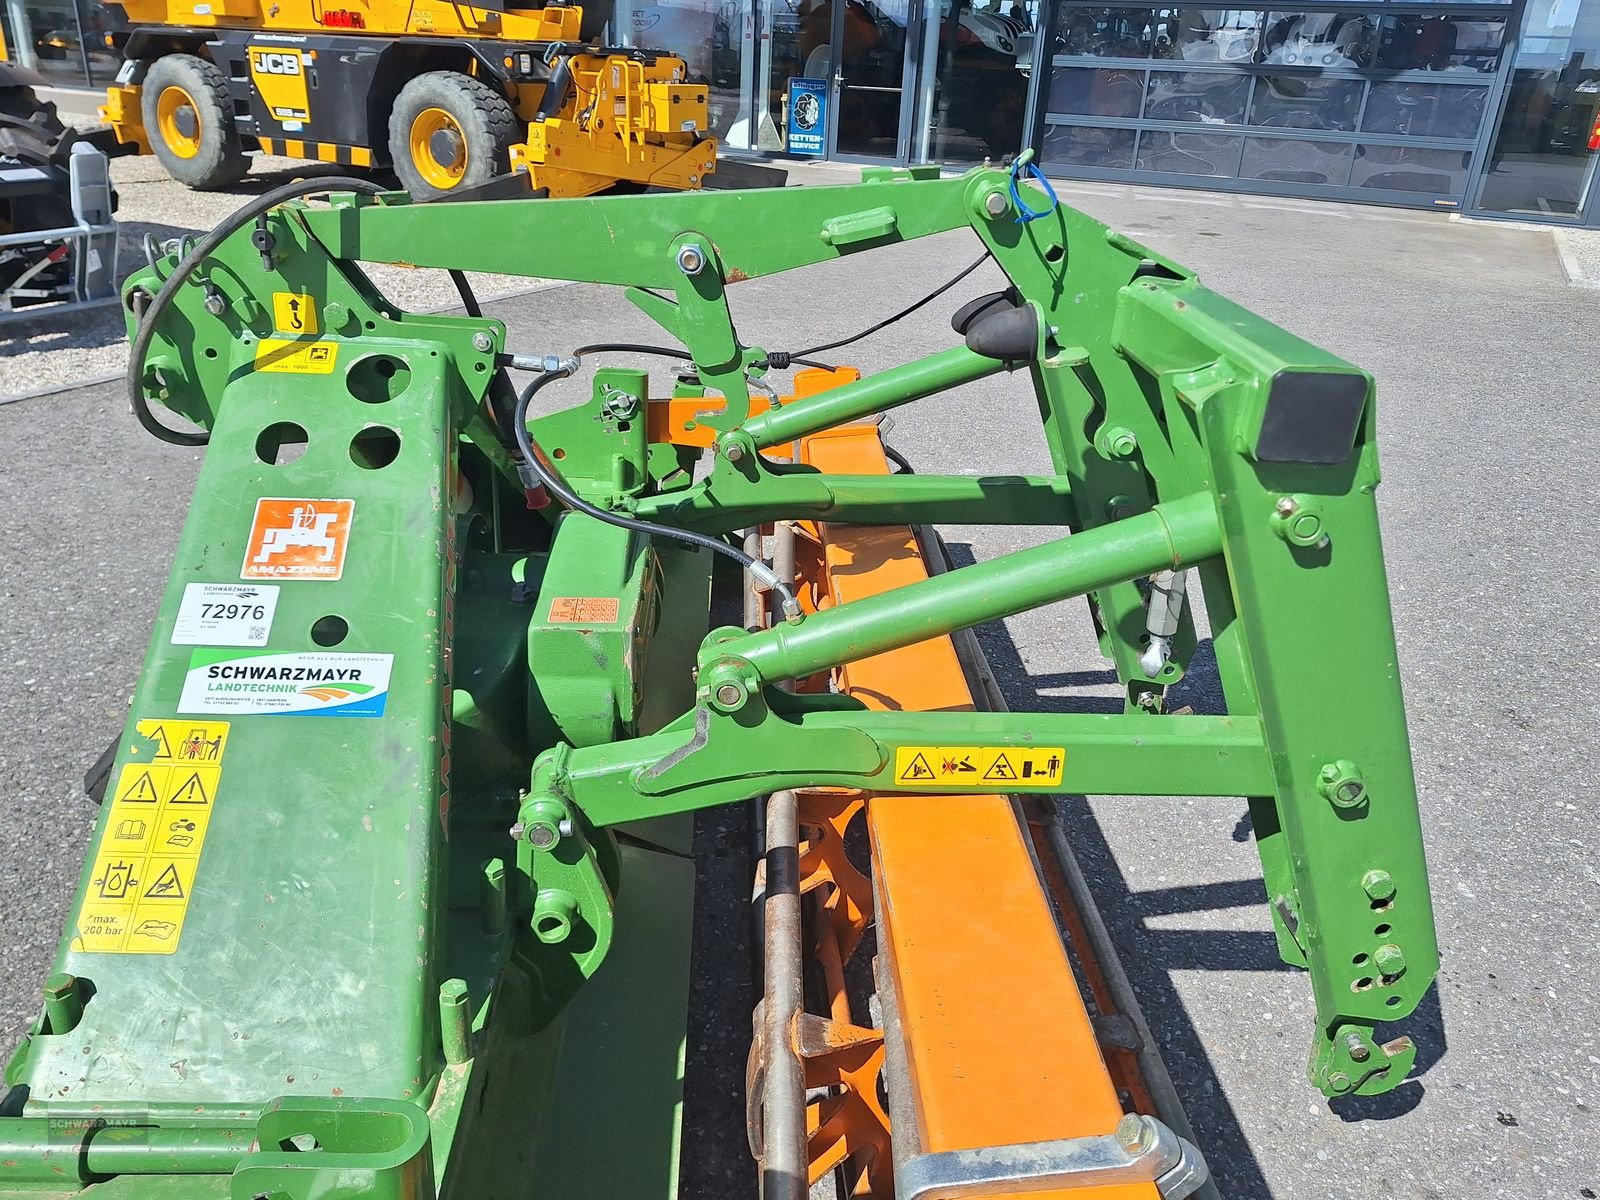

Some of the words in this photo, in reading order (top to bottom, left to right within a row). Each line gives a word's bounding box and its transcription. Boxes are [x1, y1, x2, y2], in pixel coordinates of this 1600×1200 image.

[255, 53, 300, 75] JCB
[789, 134, 824, 142] KETTEN-
[789, 141, 820, 150] SERVICE
[246, 565, 337, 574] AMAZONE
[201, 604, 265, 620] 72976
[207, 666, 362, 681] SCHWARZMAYR
[207, 682, 298, 693] LANDTECHNIK
[93, 916, 118, 924] max.
[83, 926, 102, 935] 200
[105, 926, 124, 935] bar
